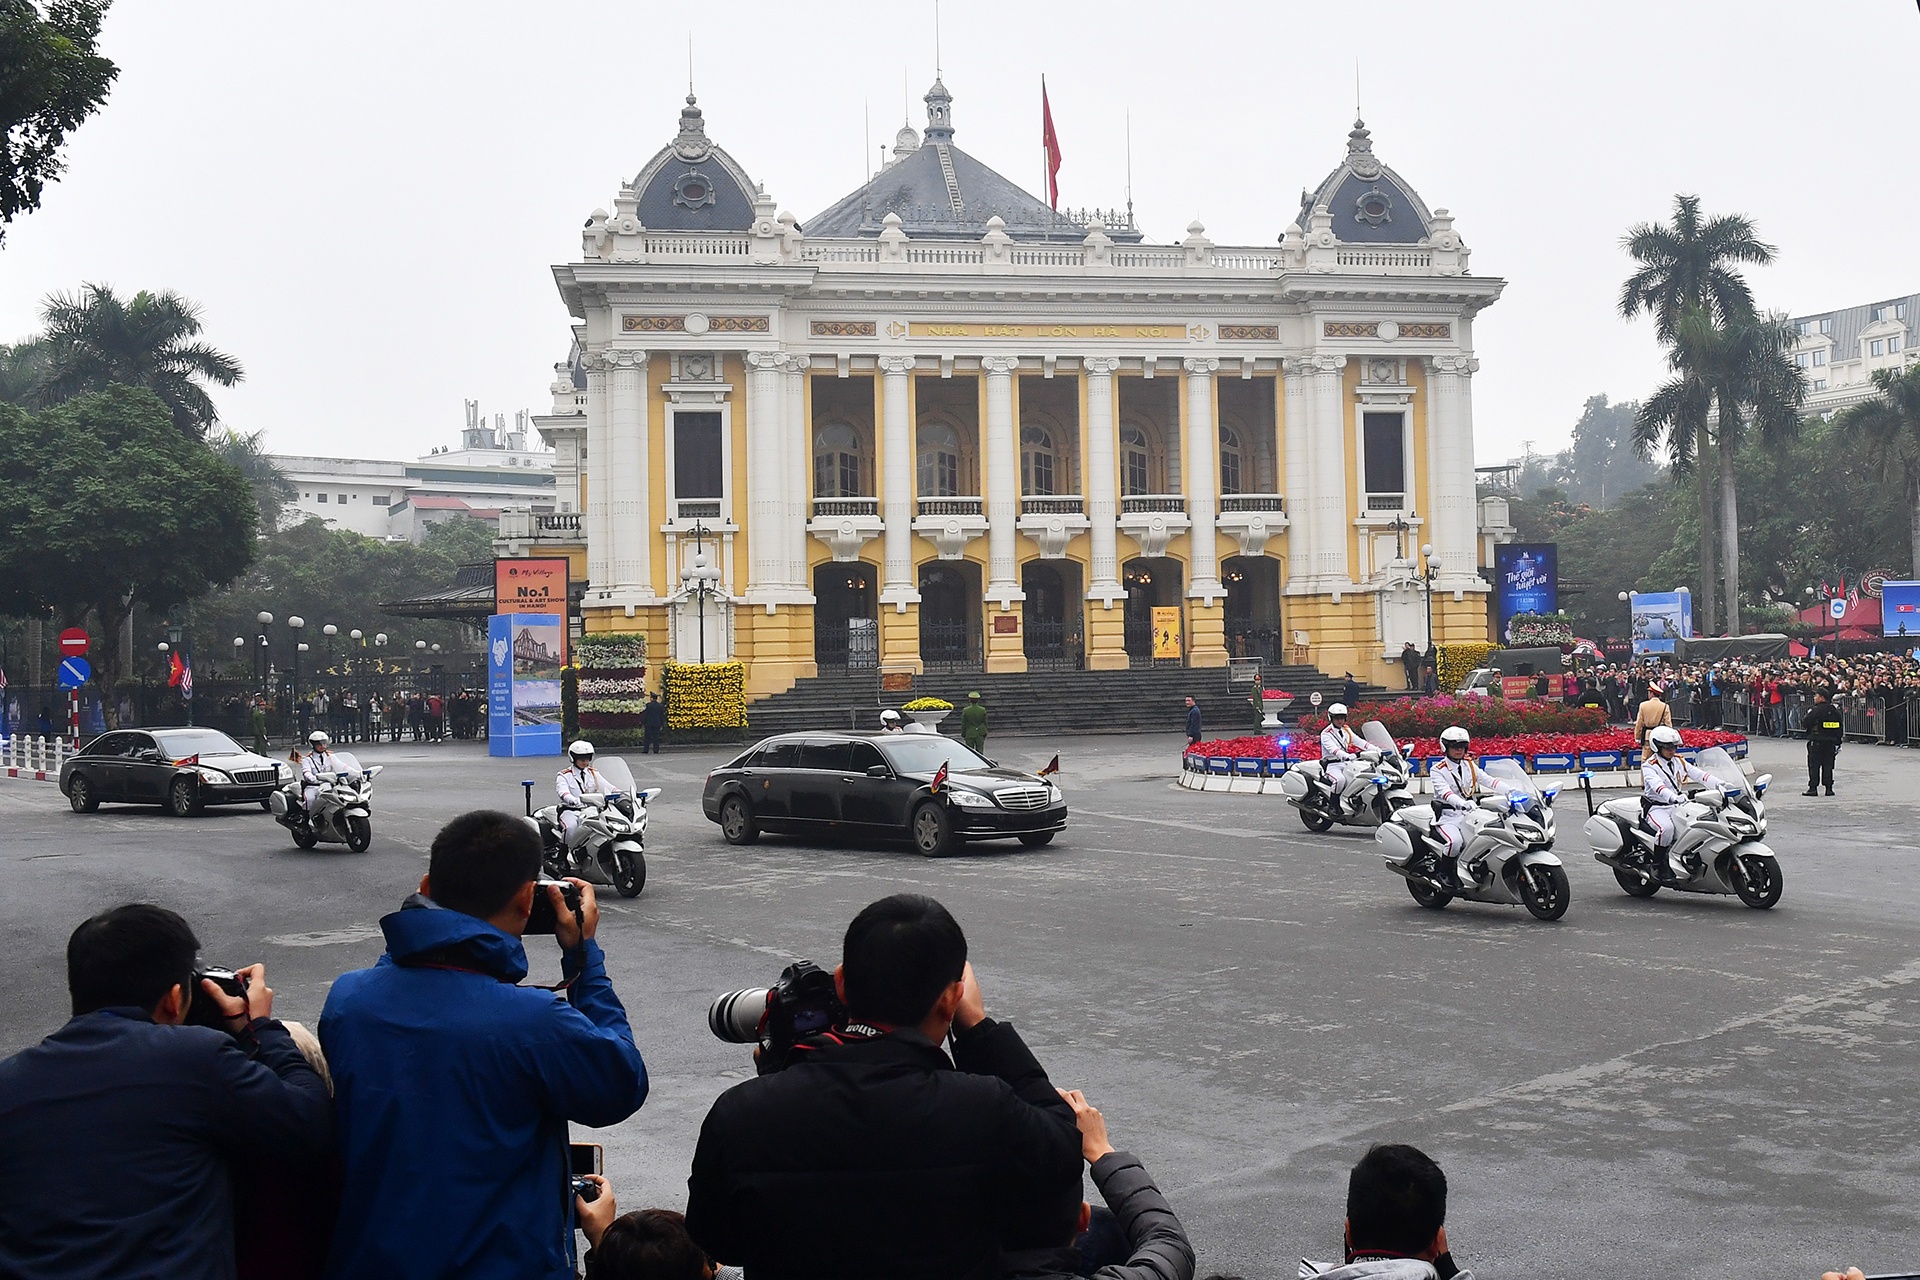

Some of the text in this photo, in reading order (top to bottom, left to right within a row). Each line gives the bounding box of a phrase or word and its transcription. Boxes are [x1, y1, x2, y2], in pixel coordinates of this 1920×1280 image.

[521, 569, 532, 577] My
[532, 568, 553, 578] Village
[517, 586, 549, 597] No.1
